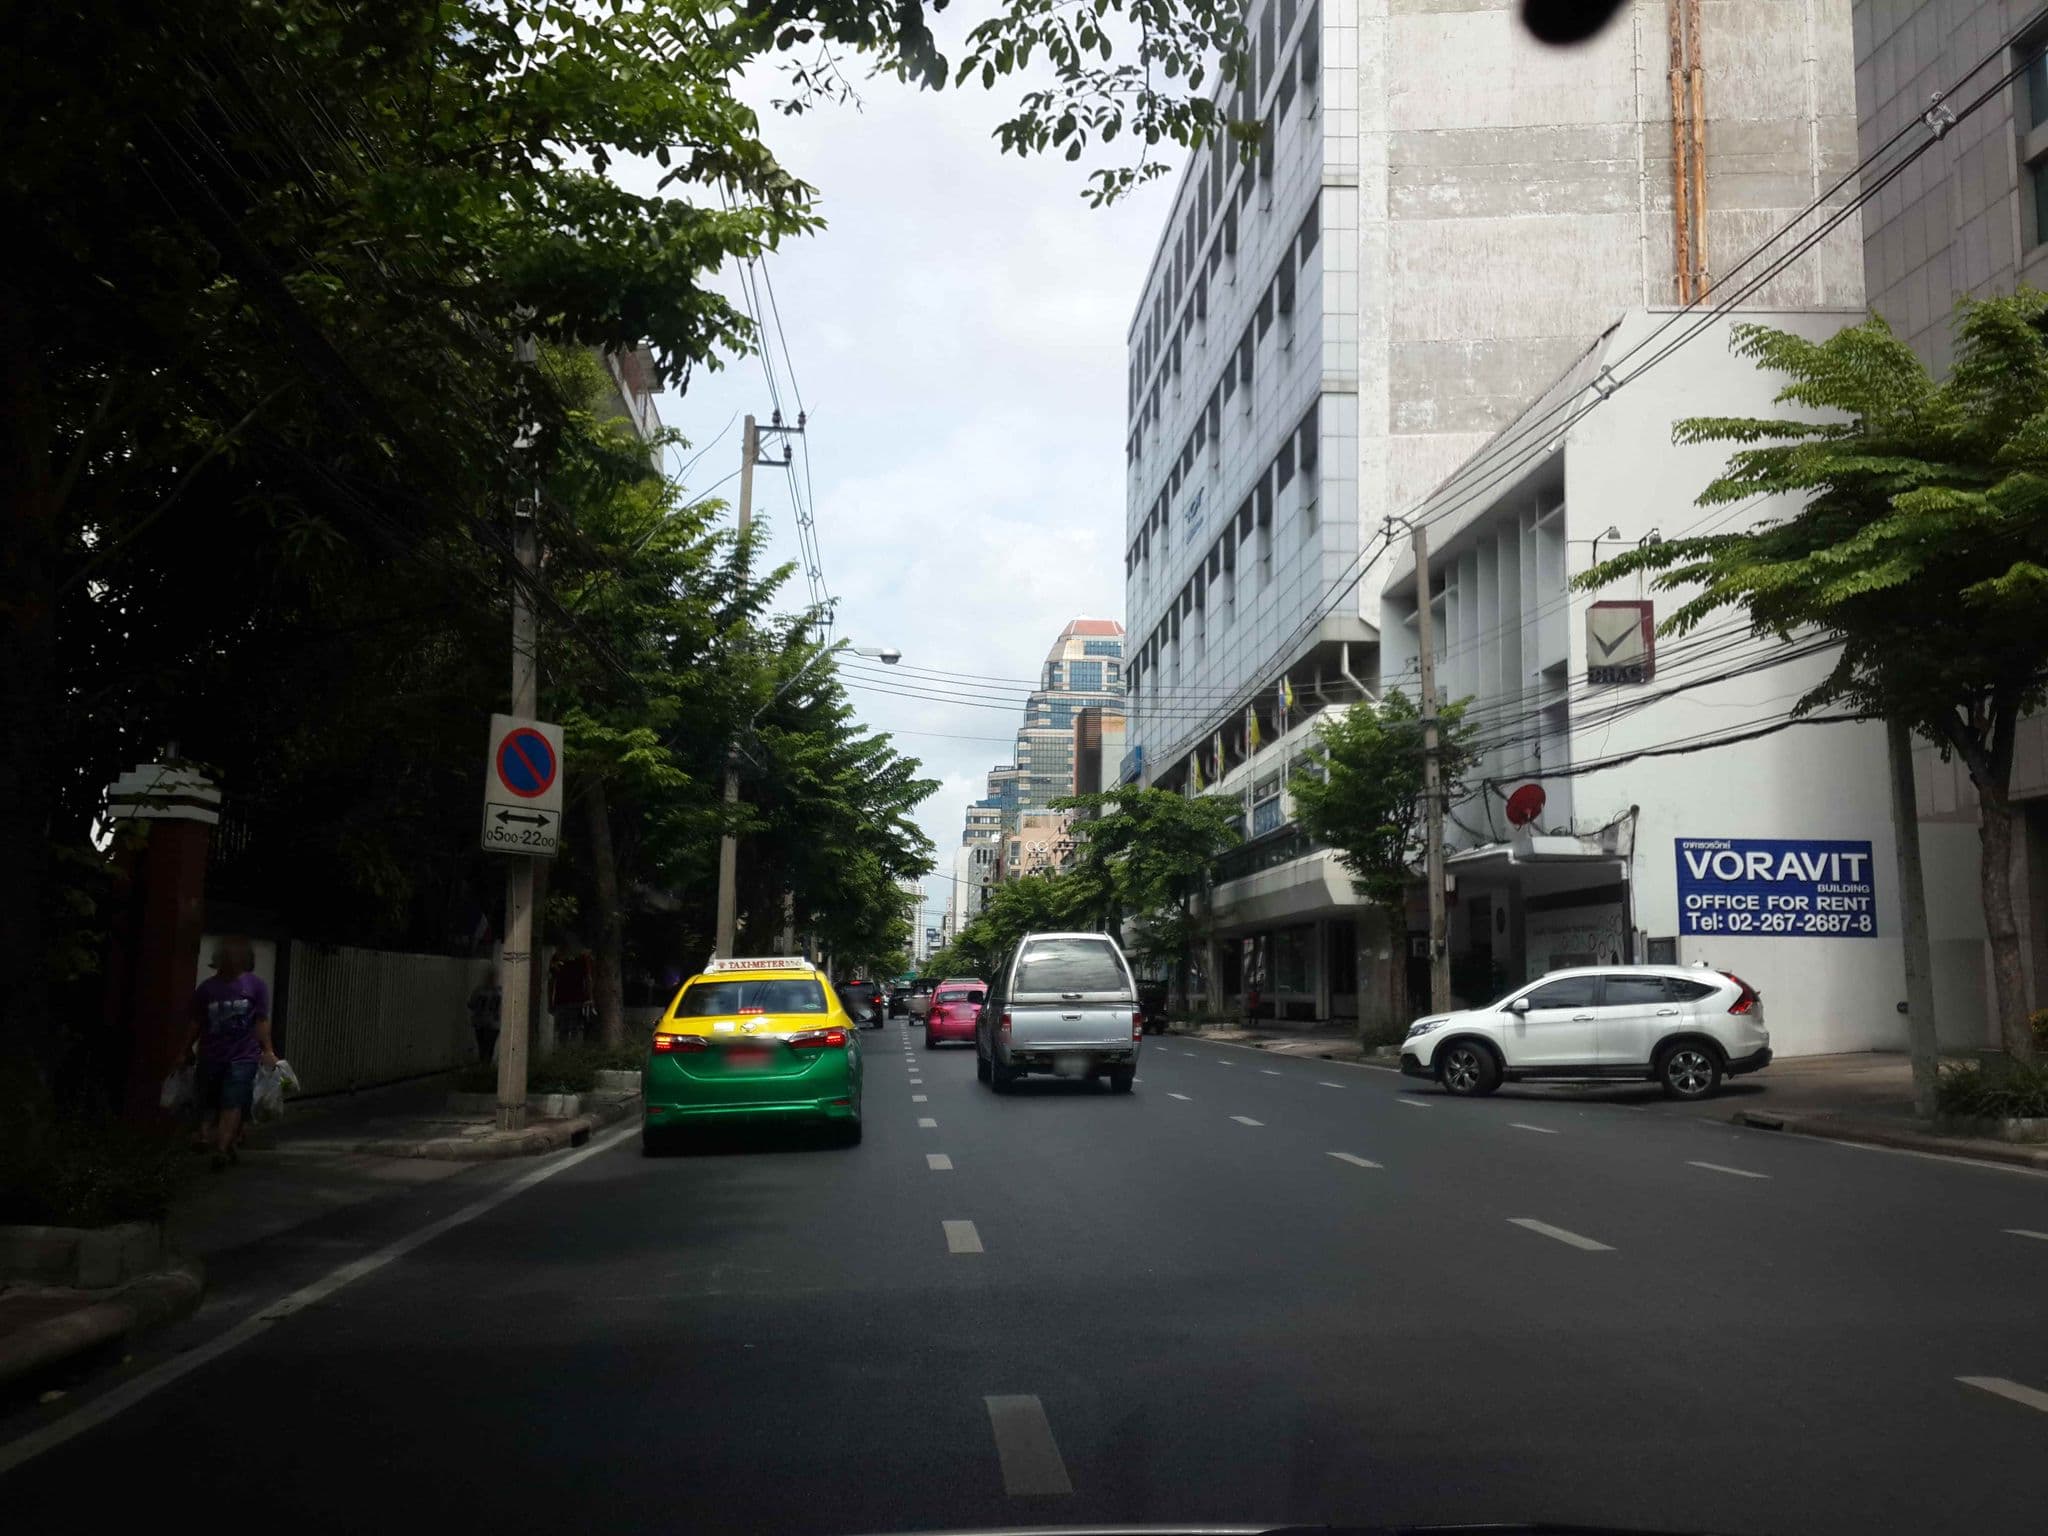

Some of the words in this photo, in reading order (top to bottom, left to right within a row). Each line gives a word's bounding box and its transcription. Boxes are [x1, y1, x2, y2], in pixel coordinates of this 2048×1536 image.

[1683, 850, 1869, 882] VORAVIT
[1817, 884, 1870, 894] BUILDING
[1685, 894, 1760, 910] OFFICE
[1767, 895, 1810, 911] FOR
[1816, 896, 1871, 912] RENT
[1686, 912, 1724, 931] Tel:
[1727, 912, 1872, 933] 02-267-2687-8
